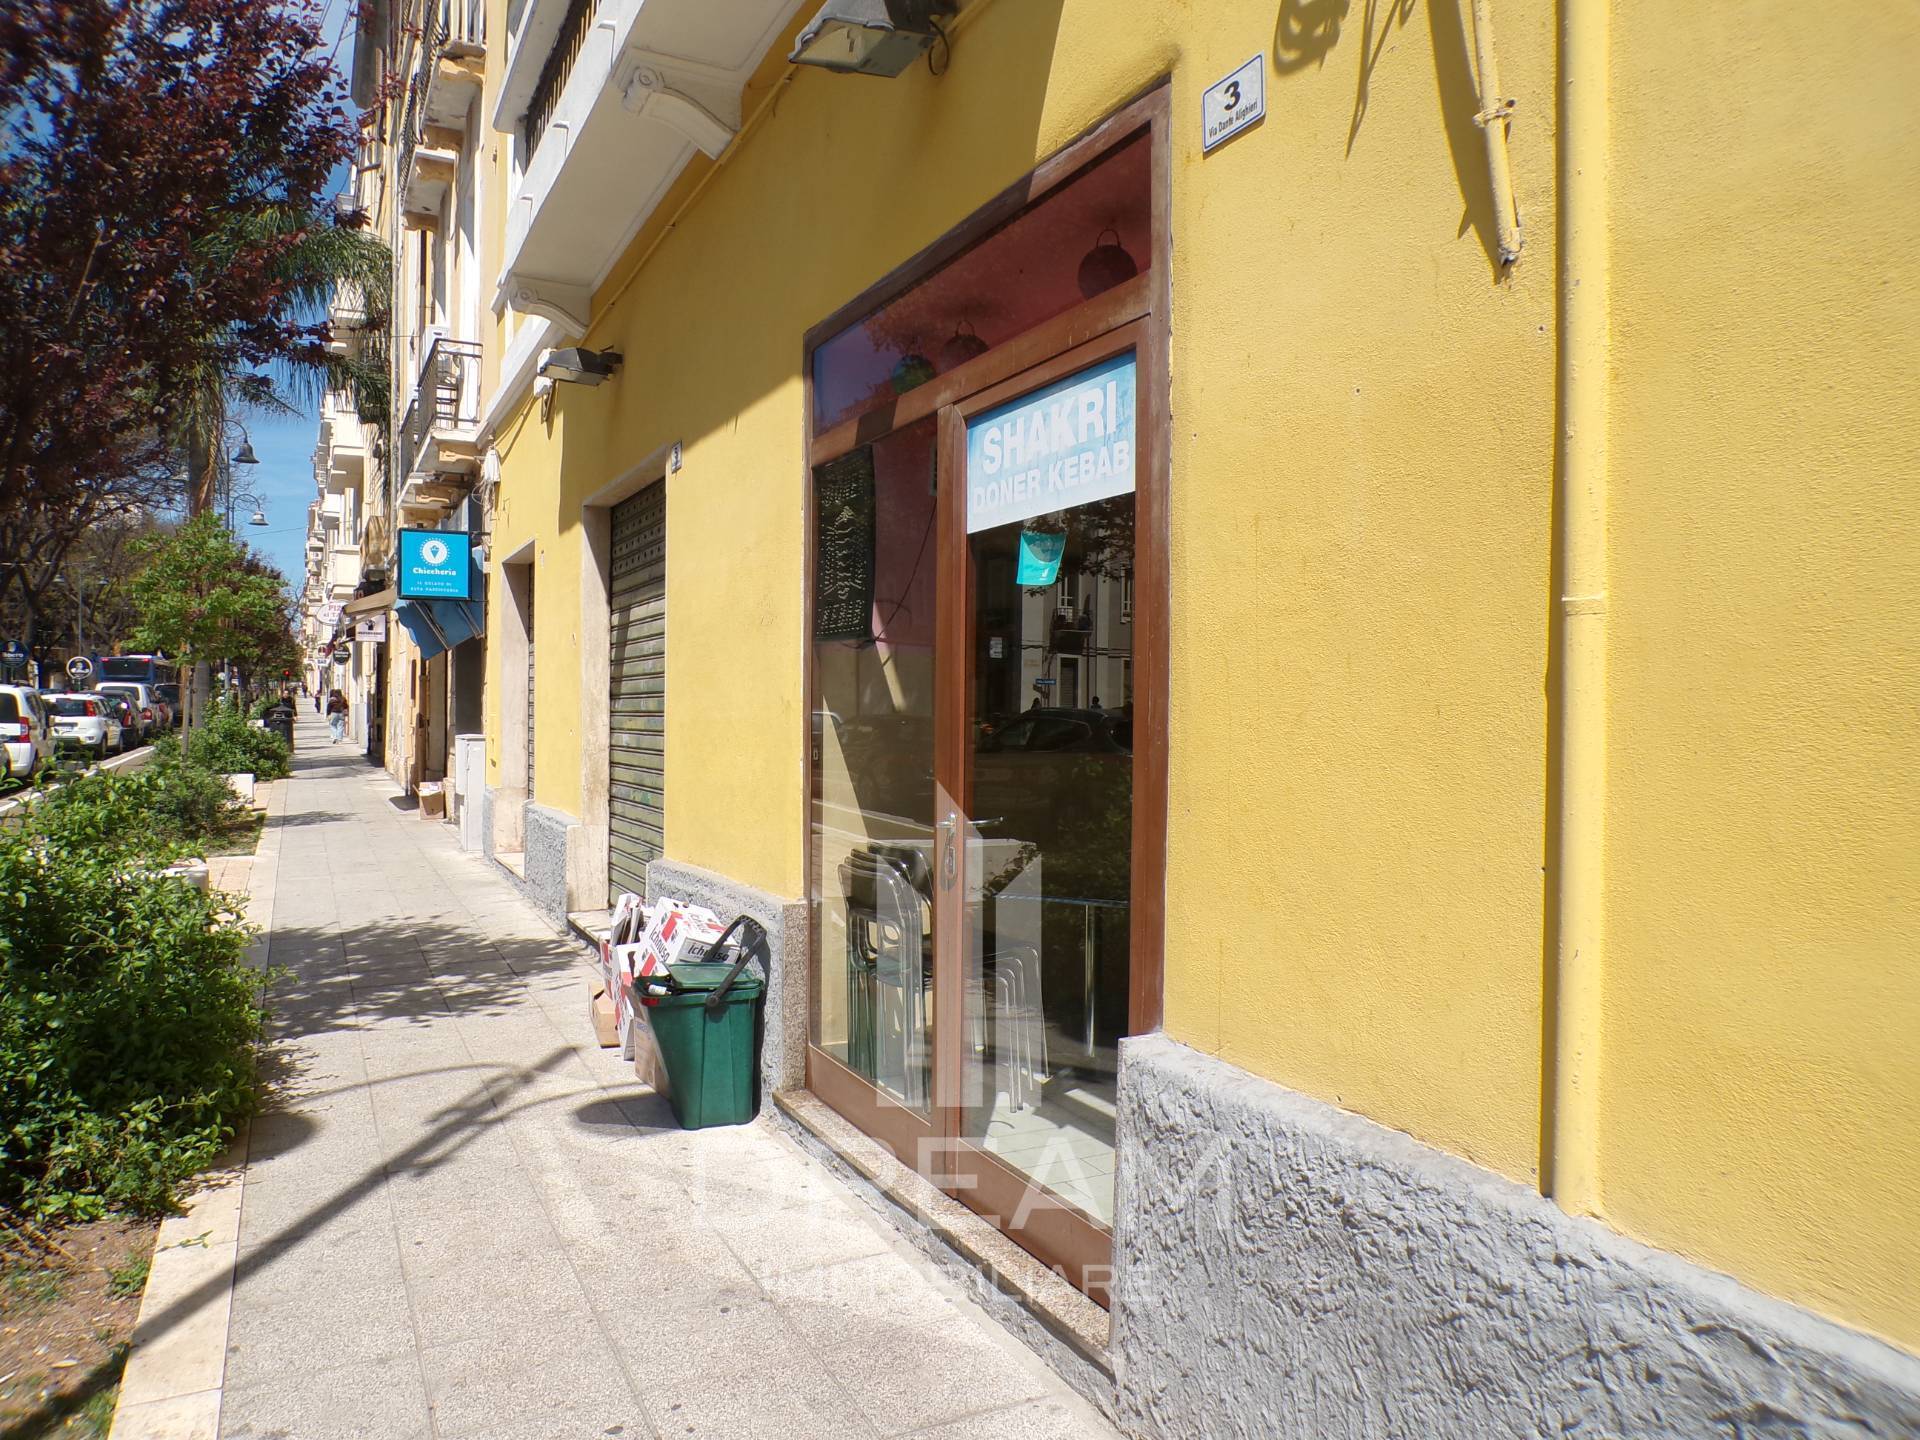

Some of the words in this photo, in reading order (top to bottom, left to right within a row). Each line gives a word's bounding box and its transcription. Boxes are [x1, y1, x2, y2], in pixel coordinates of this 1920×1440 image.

[1209, 127, 1218, 138] Via
[1218, 116, 1234, 132] Dante
[1235, 100, 1258, 121] Alighieri
[1224, 80, 1241, 111] 3
[983, 380, 1117, 474] SHAKRI
[973, 468, 1041, 509] DONER
[1048, 440, 1130, 491] KEBAB
